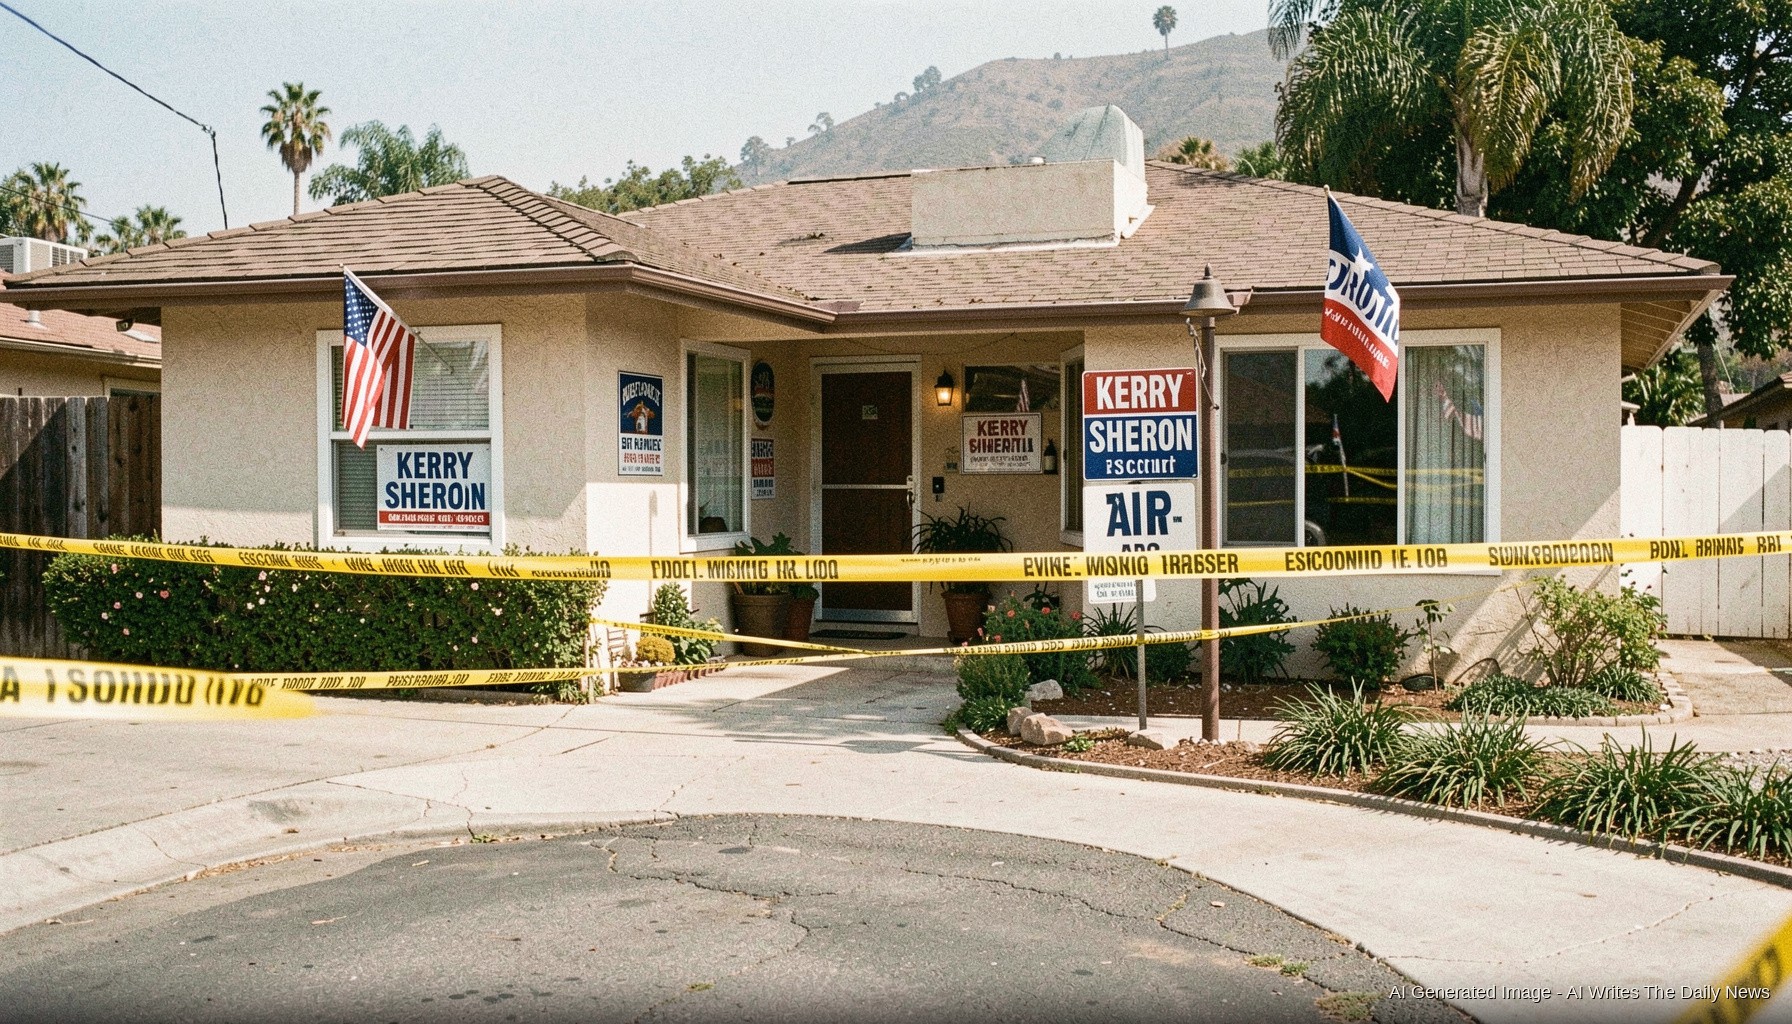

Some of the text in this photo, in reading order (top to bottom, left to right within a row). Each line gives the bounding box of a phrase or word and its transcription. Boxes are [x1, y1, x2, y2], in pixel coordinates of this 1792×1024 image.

[1096, 374, 1184, 410] KERRY
[977, 420, 1028, 436] KERRY
[1089, 418, 1193, 453] SHERON
[397, 452, 474, 479] KERRY
